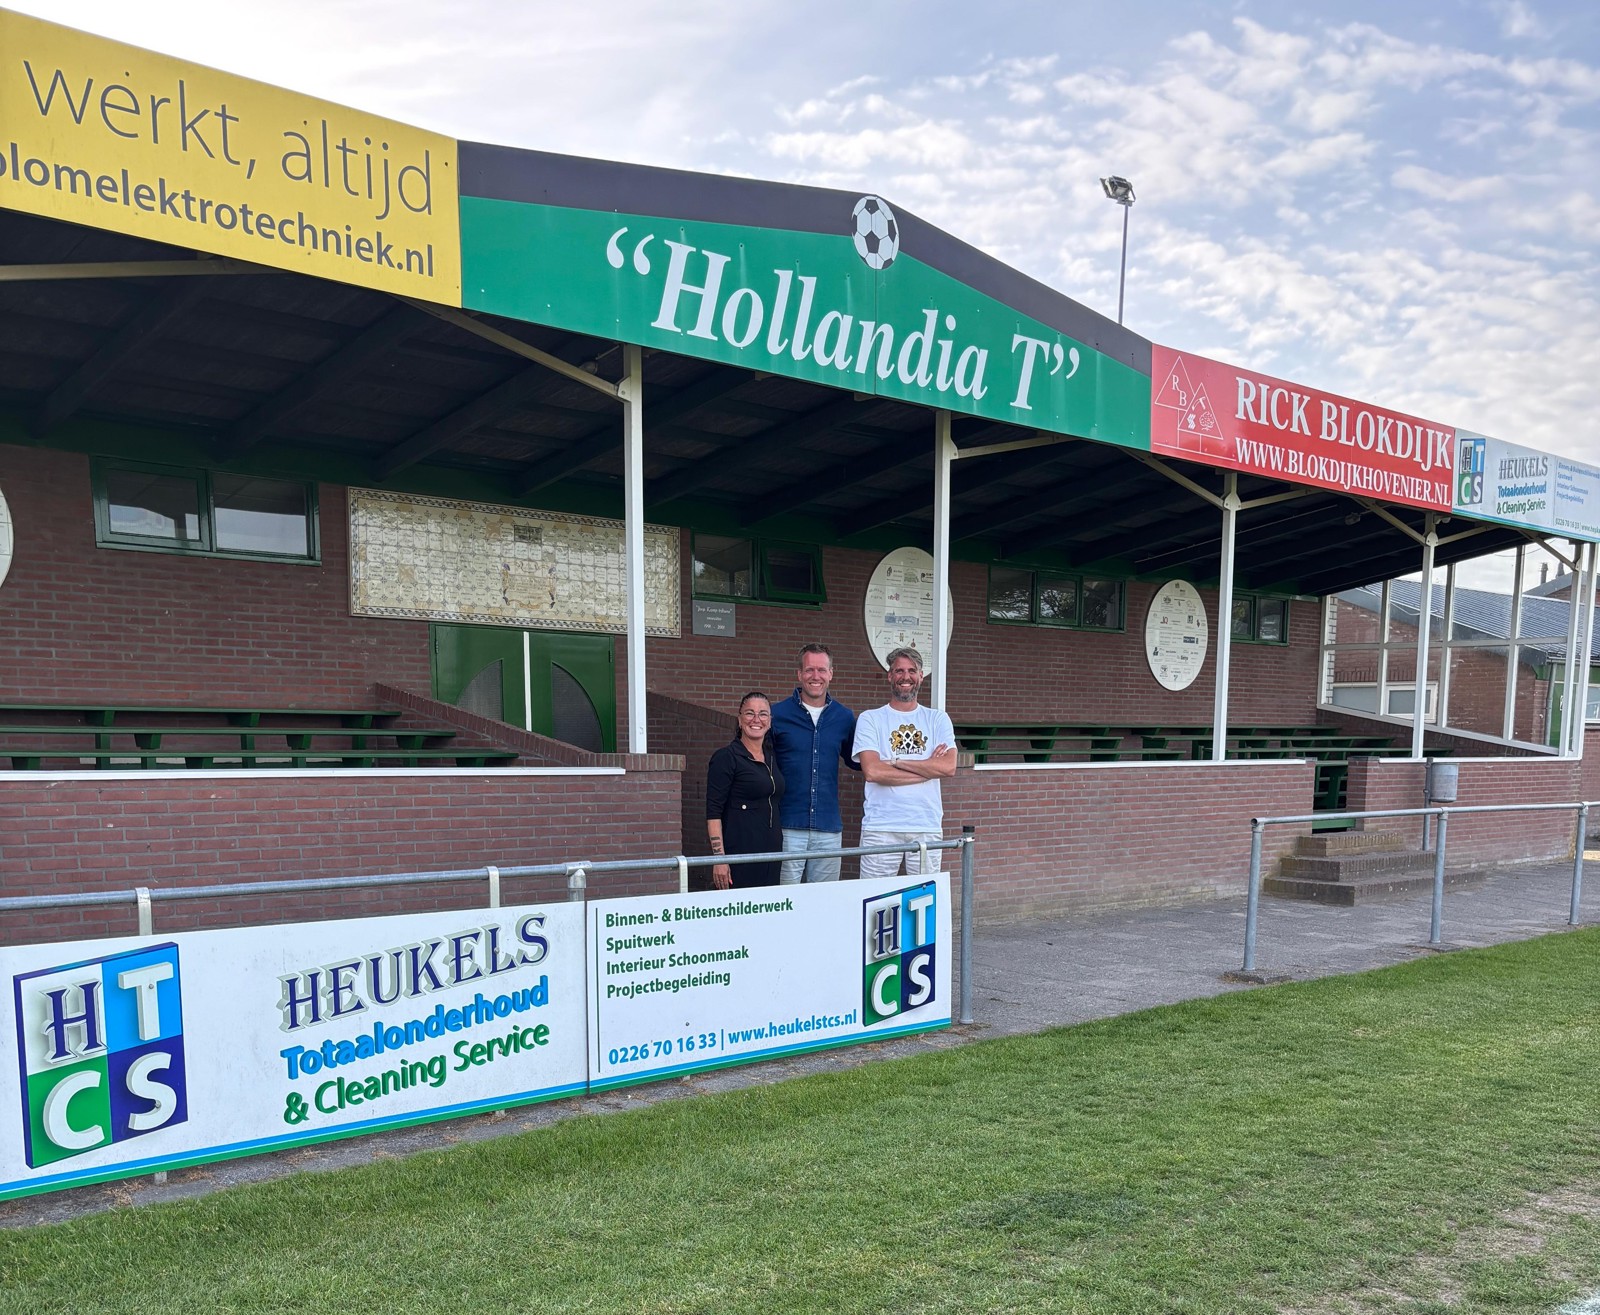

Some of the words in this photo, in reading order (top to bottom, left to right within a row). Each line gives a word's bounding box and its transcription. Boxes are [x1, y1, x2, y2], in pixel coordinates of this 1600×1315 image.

[23, 59, 257, 181] werkt,
[281, 119, 433, 221] altijd
[1235, 376, 1312, 437] RICK
[1319, 399, 1452, 472] BLOKDIJK
[1235, 436, 1451, 507] WWW.BLOKDIJKHOVENIER.NL
[1499, 456, 1548, 480] HEUKELS
[1502, 500, 1527, 515] Cleaning
[1527, 498, 1546, 511] Service
[605, 912, 659, 928] Binnen-
[661, 908, 672, 922] &
[674, 897, 794, 921] Buitenschilderwerk
[606, 930, 675, 954] Spuitwerk
[606, 957, 666, 975] Interieur
[668, 945, 749, 968] Schoonmaak
[276, 911, 551, 1034] HEUKELS
[606, 970, 731, 999] Projectbegeleiding
[280, 974, 549, 1080] Totaalonderhoud
[608, 1043, 650, 1065] 0226
[653, 1039, 673, 1058] 70
[677, 1035, 695, 1054] 16
[698, 1032, 717, 1049] 33
[727, 1008, 857, 1044] www.heukelstcs.nl
[283, 1091, 310, 1125] &
[314, 1055, 447, 1114] Cleaning
[453, 1023, 550, 1072] Service
